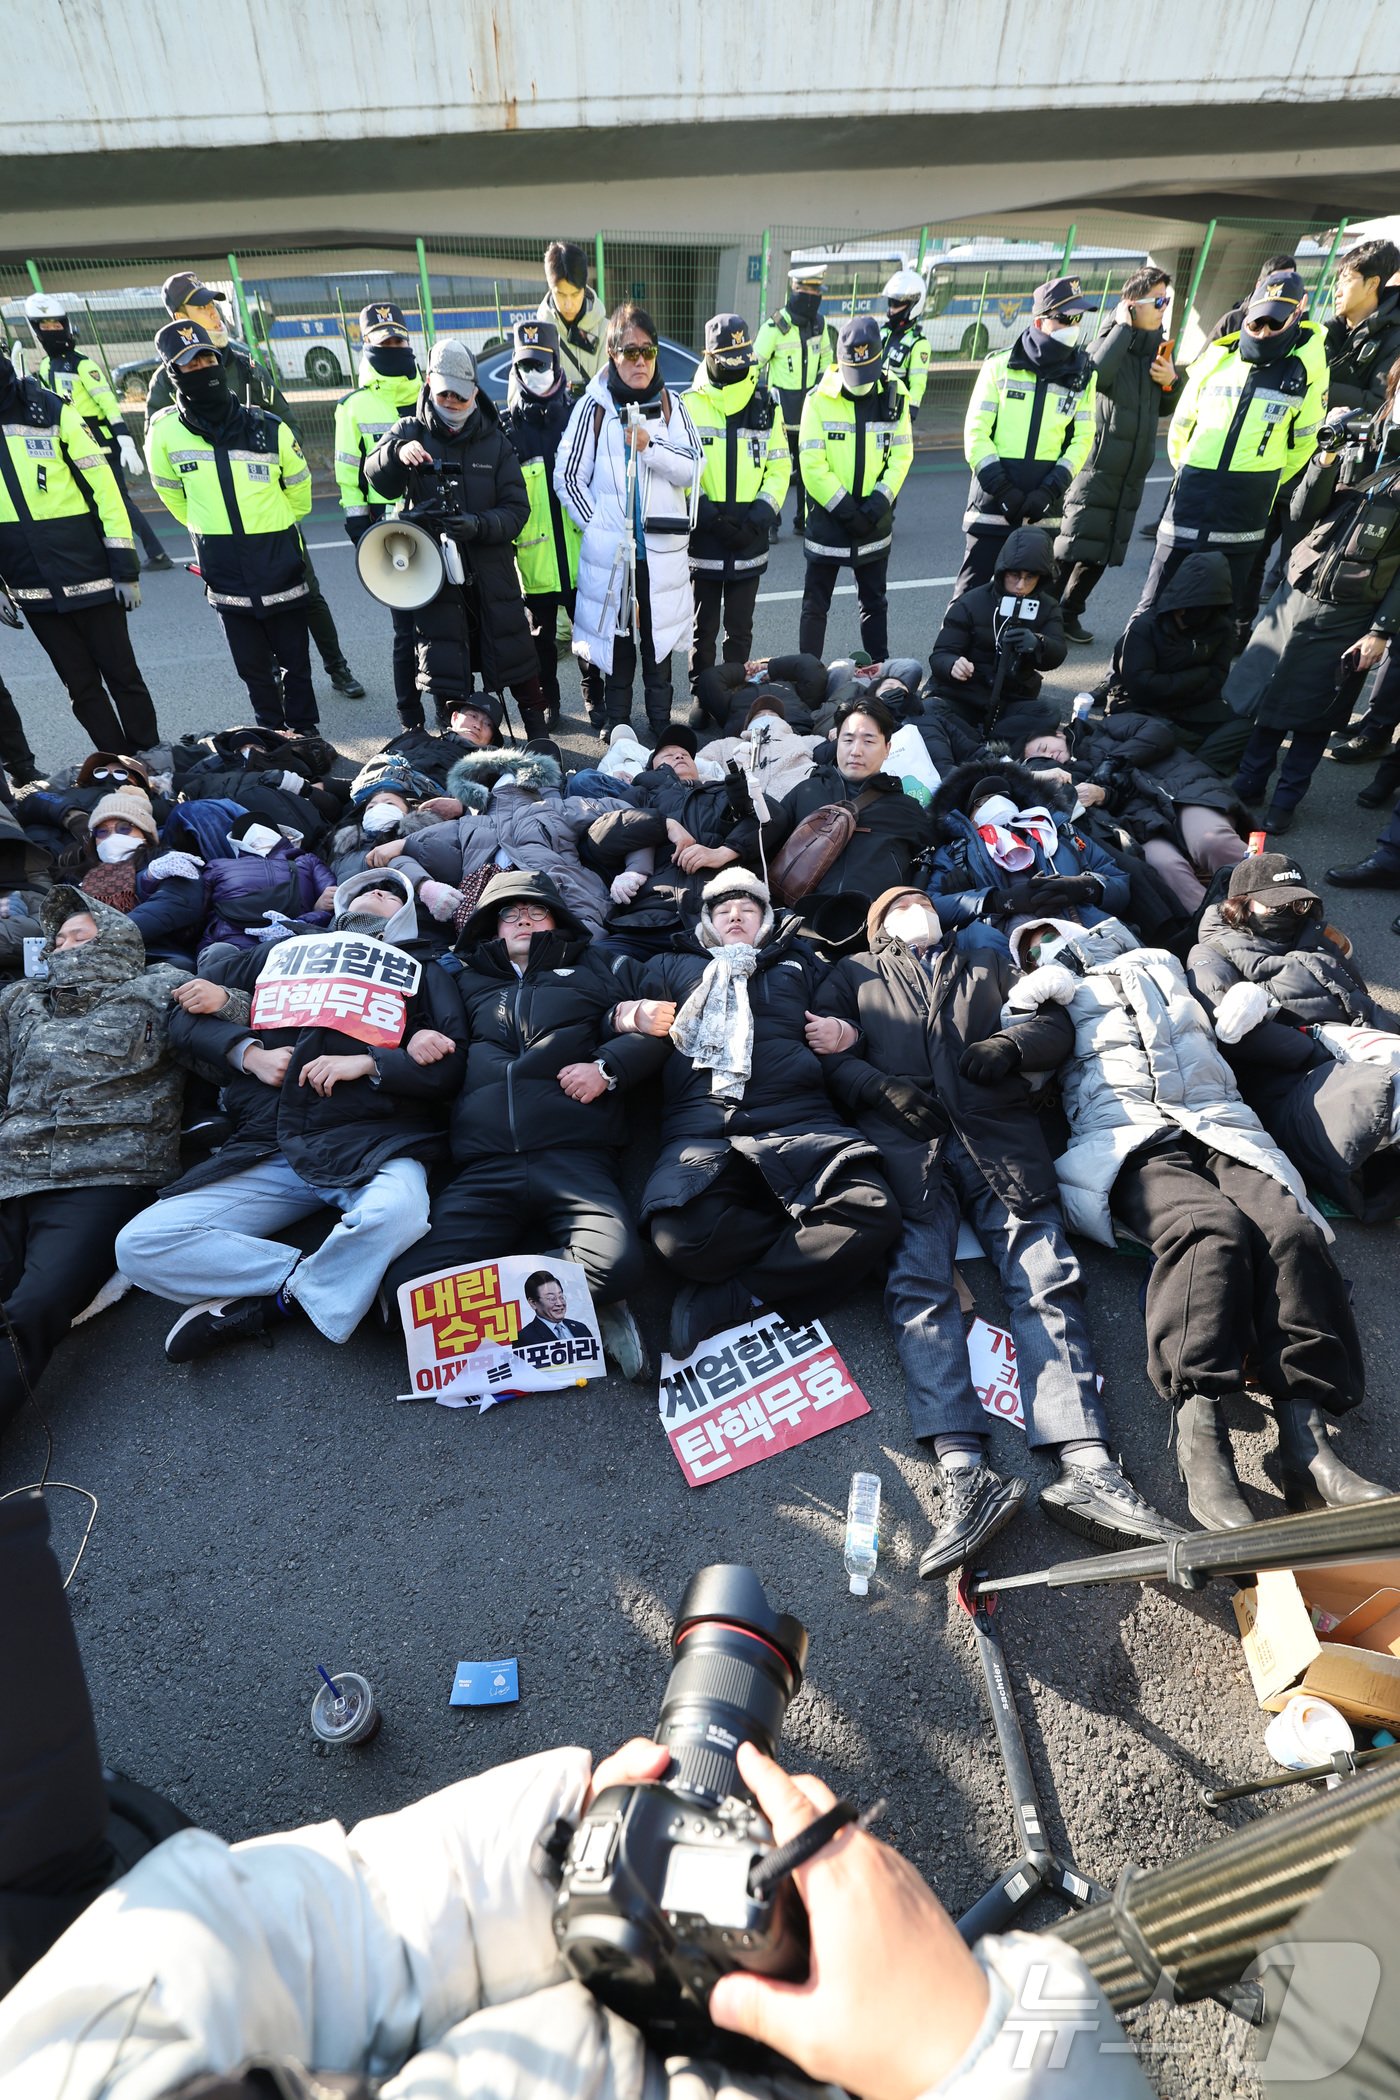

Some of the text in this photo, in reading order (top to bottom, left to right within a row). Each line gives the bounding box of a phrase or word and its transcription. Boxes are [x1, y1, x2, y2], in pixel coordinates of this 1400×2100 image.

[267, 942, 417, 990] 계엄합법
[253, 982, 406, 1033] 탄핵무효
[414, 1267, 499, 1321] 내란
[437, 1303, 519, 1353] 수괴
[660, 1320, 824, 1418] 계엄합법
[675, 1356, 854, 1479] 탄핵무효
[993, 1662, 1009, 1710] sachtler
